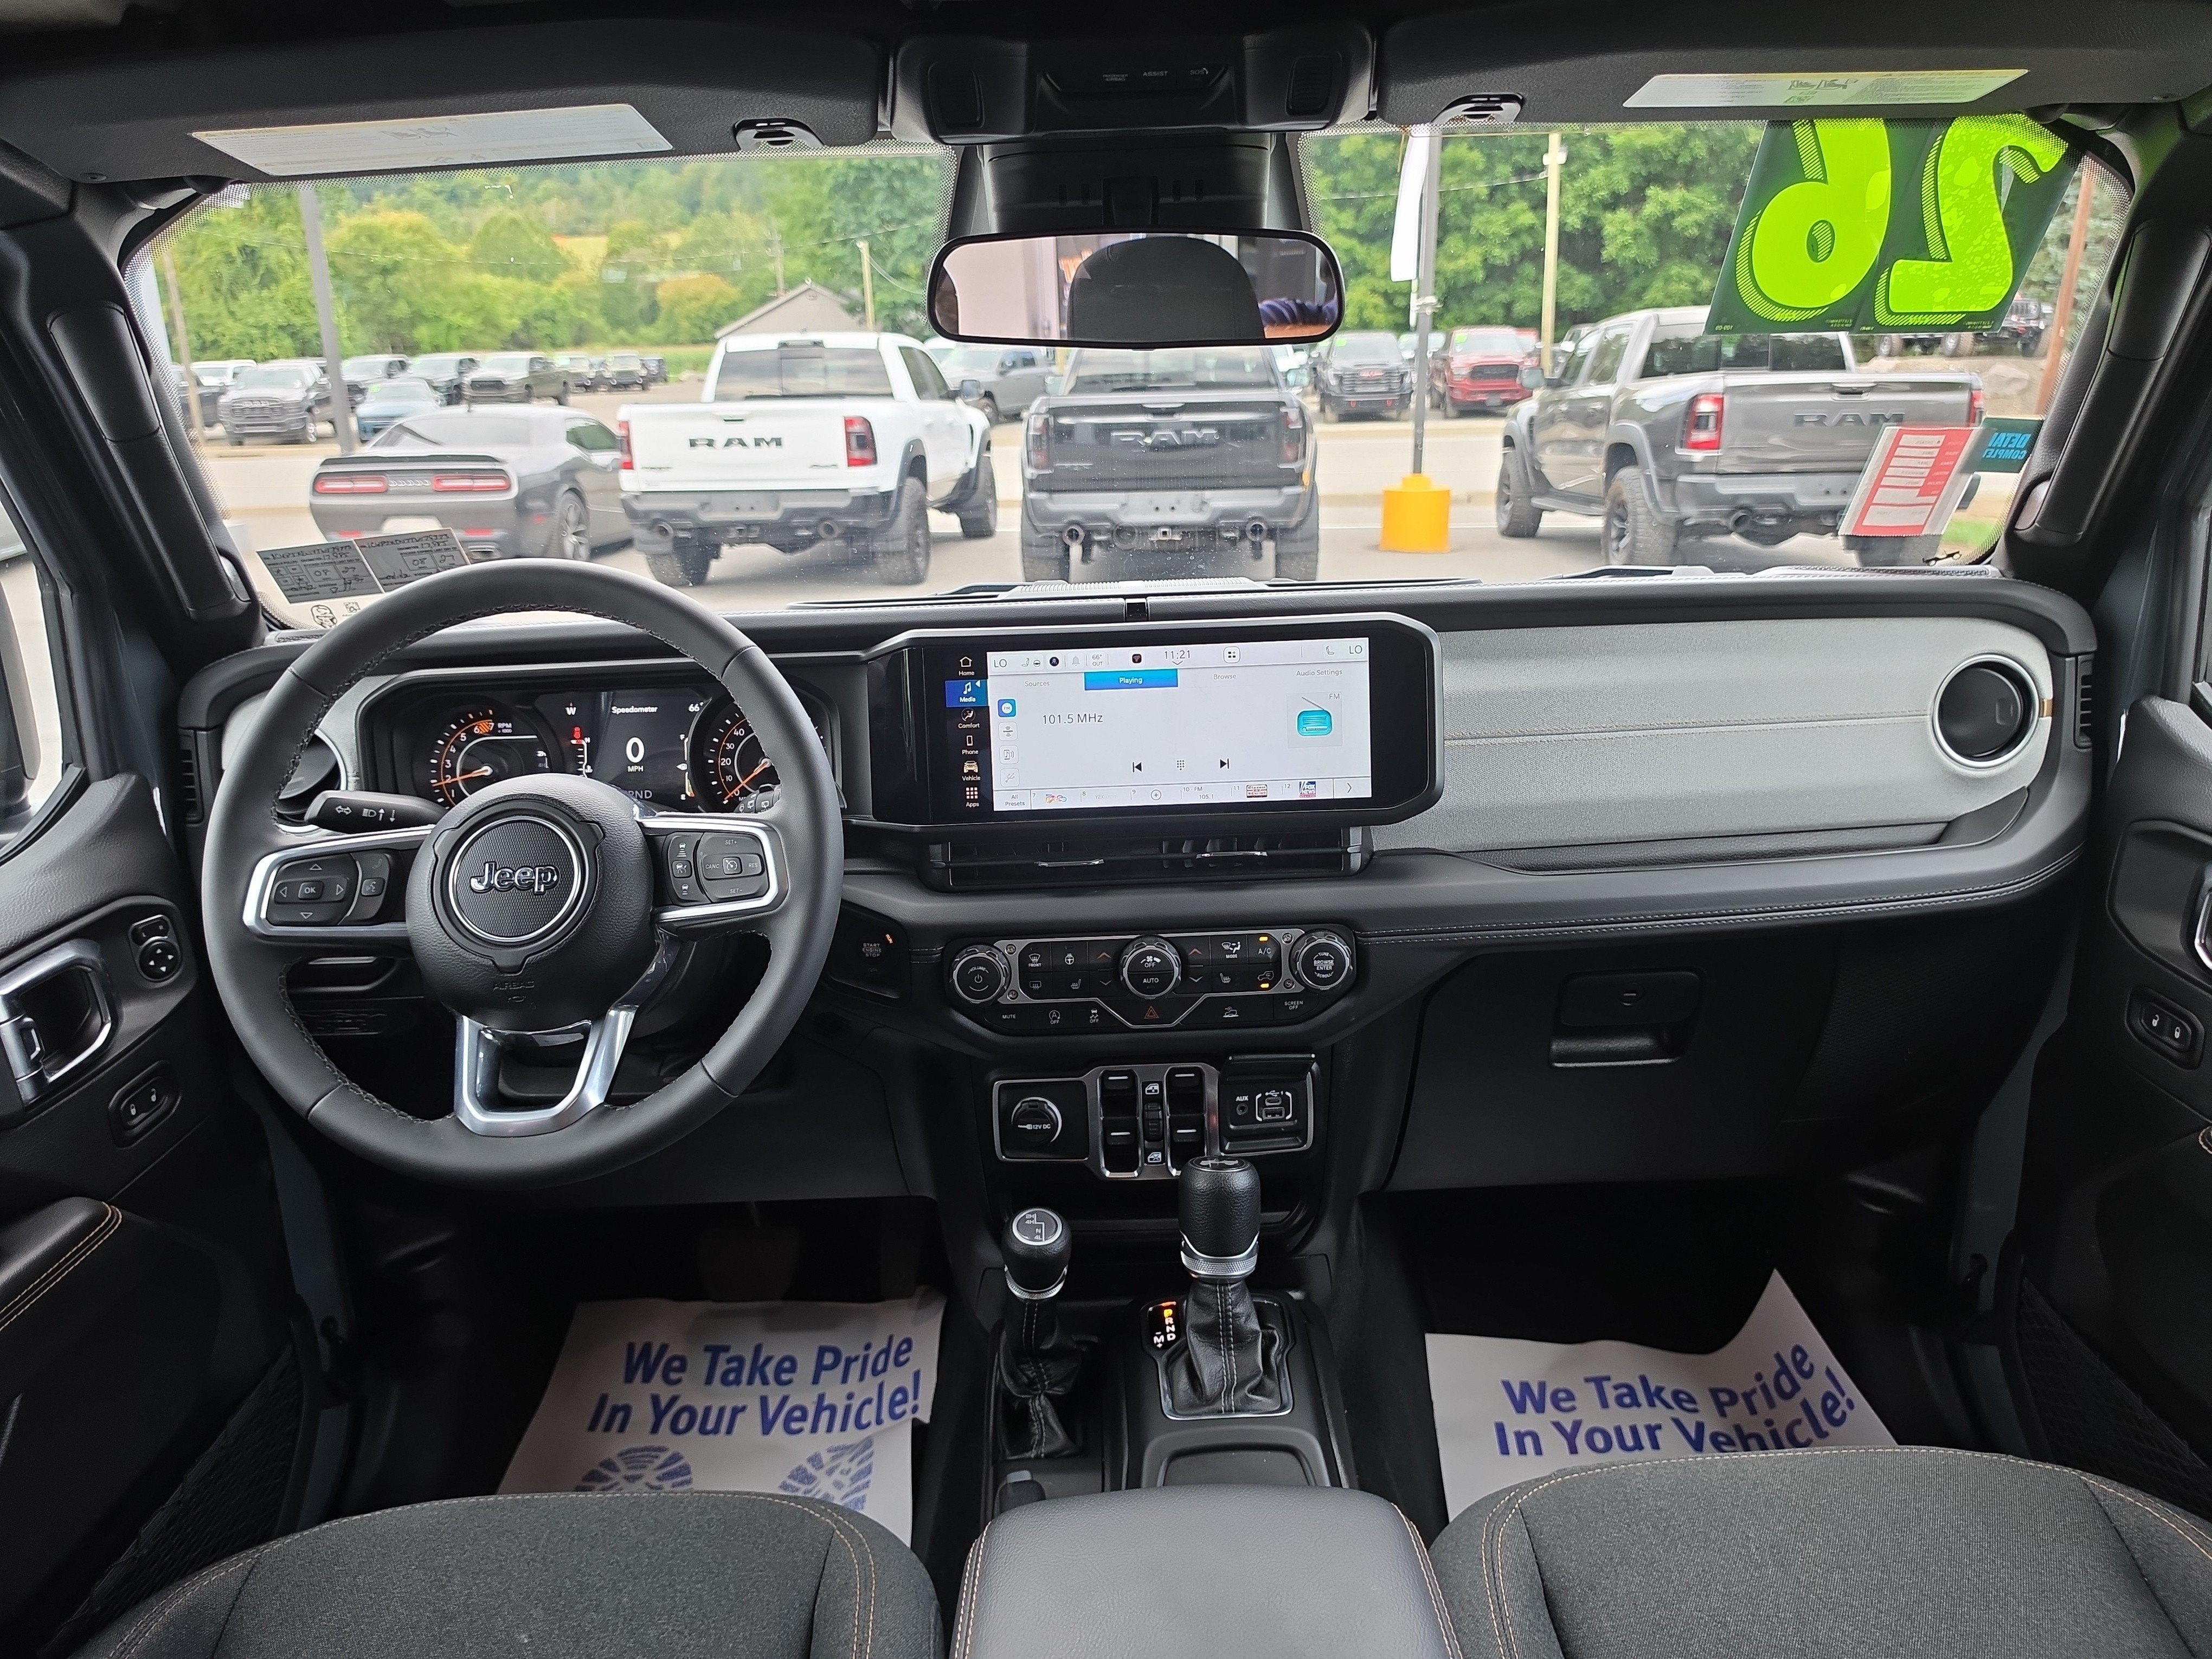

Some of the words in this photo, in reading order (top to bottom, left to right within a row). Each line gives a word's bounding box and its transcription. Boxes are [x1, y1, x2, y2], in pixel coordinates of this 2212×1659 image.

[1793, 409, 1906, 427] RAM
[689, 437, 783, 449] RAM
[1349, 645, 1362, 654] LO
[1164, 650, 1191, 660] 11:21
[994, 659, 1007, 668] LO
[1118, 677, 1143, 685] Playing
[612, 706, 658, 714] Speedometer
[1043, 713, 1074, 725] 101.5
[1077, 713, 1104, 724] MHz
[489, 723, 494, 731] 7
[733, 728, 745, 736] 40
[626, 737, 645, 763] 0
[445, 760, 452, 768] 3
[721, 758, 731, 766] 20
[451, 789, 455, 798] 1
[470, 862, 561, 896] Jeep
[304, 886, 317, 895] OK
[1258, 947, 1271, 955] A/C
[1163, 1309, 1173, 1318] P
[1165, 1317, 1174, 1325] R
[1166, 1324, 1175, 1333] N
[1153, 1334, 1165, 1344] M
[1167, 1333, 1176, 1341] D
[623, 1341, 688, 1386] We
[703, 1343, 798, 1387] Take
[811, 1334, 914, 1386] Pride
[1500, 1379, 1577, 1414] We
[1584, 1374, 1699, 1413] Take
[1709, 1342, 1815, 1419] Pride
[587, 1393, 633, 1434] In
[650, 1394, 749, 1436] Your
[758, 1369, 922, 1436] Vehicle!
[1494, 1422, 1544, 1456] In
[1552, 1418, 1663, 1455] Your
[1671, 1366, 1855, 1453] Vehicle!
